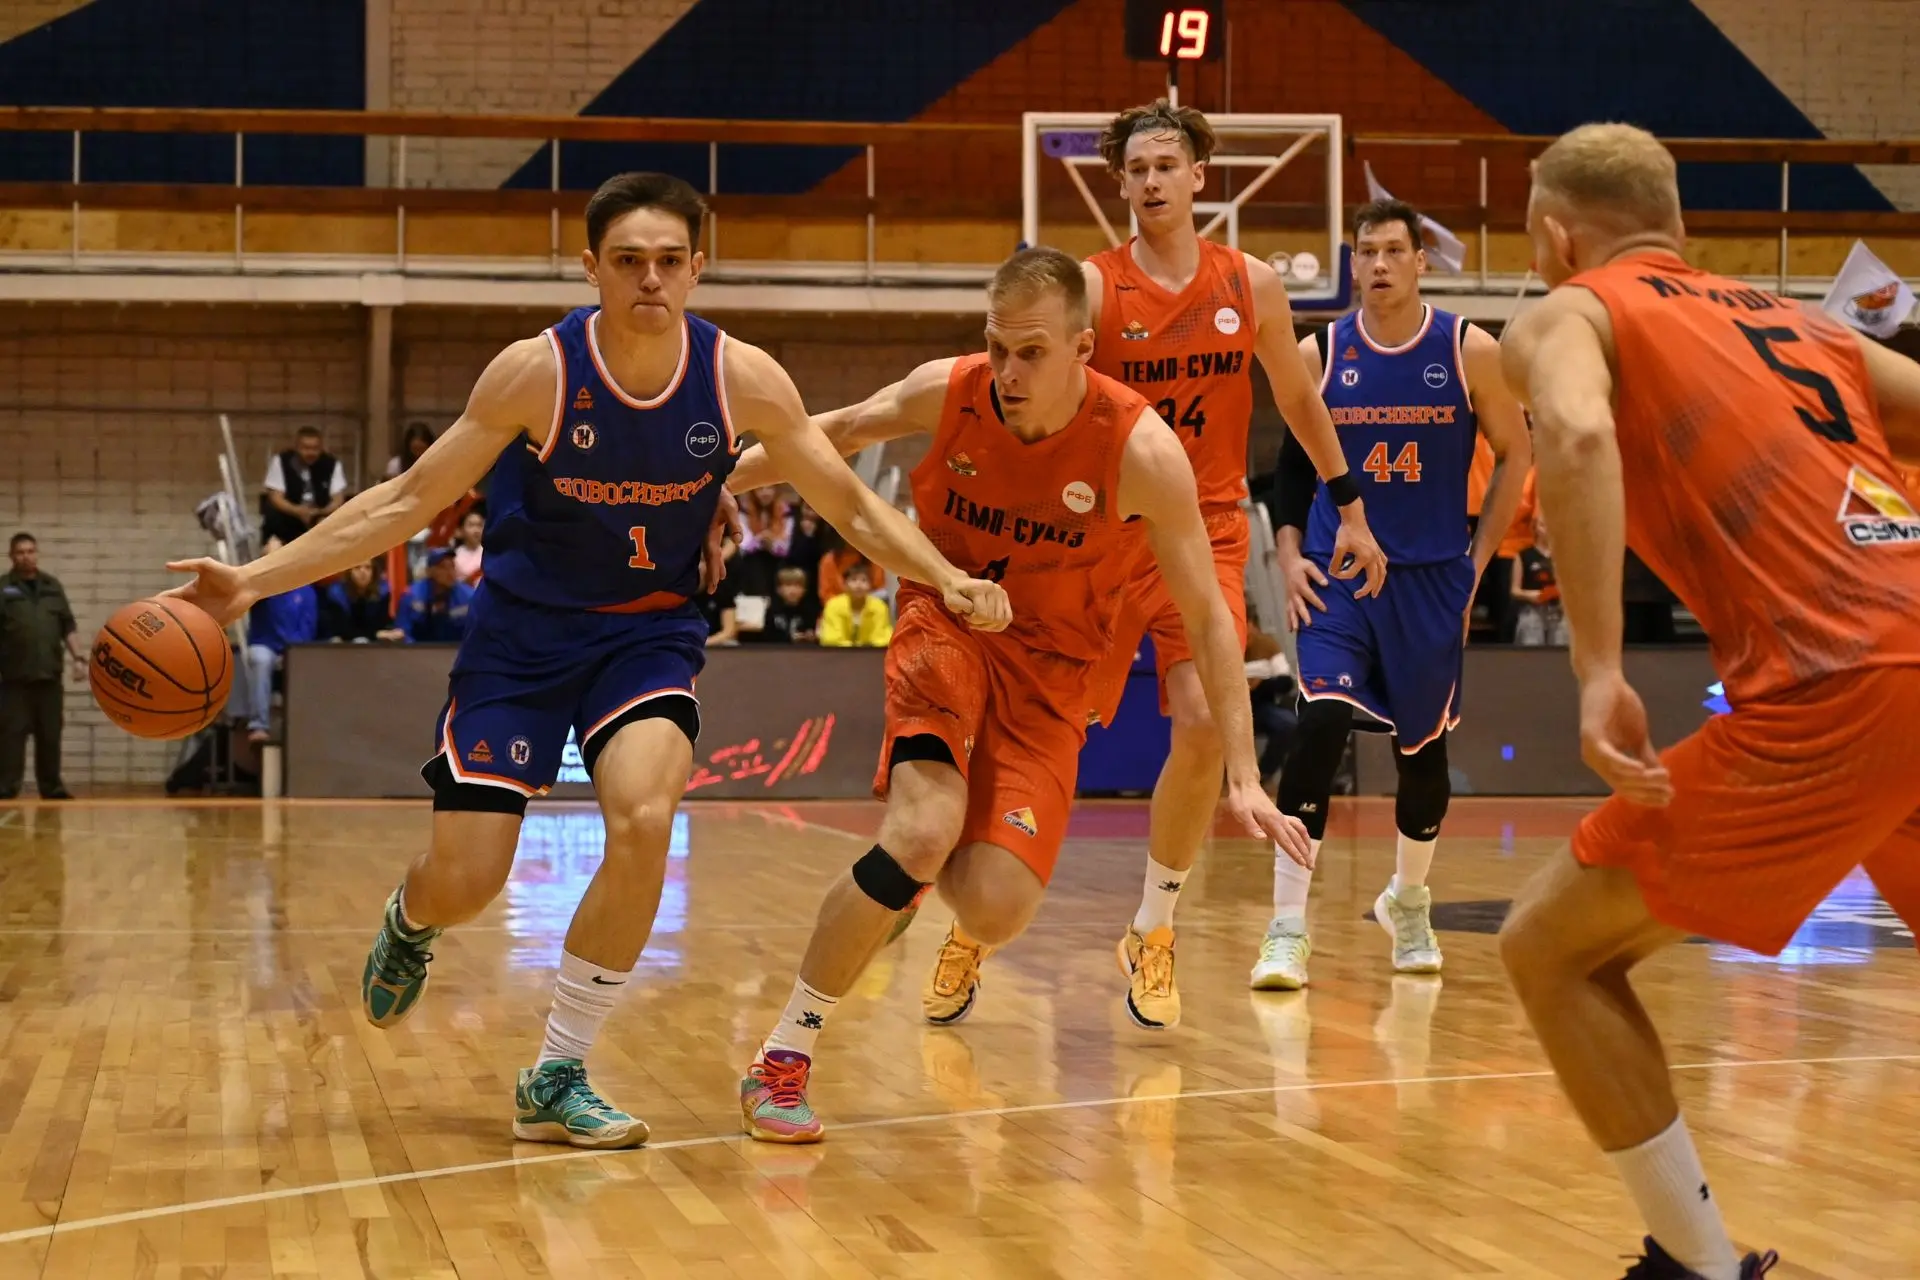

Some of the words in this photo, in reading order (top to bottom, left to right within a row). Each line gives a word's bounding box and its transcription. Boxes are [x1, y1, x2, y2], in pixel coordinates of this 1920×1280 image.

[1160, 10, 1209, 59] 19
[1120, 350, 1244, 383] ТЕМП-СУМЗ
[1732, 318, 1858, 445] 5
[690, 434, 716, 445] РФБ
[1363, 441, 1422, 483] 44
[1066, 490, 1092, 504] РФБ
[628, 526, 656, 570] 1
